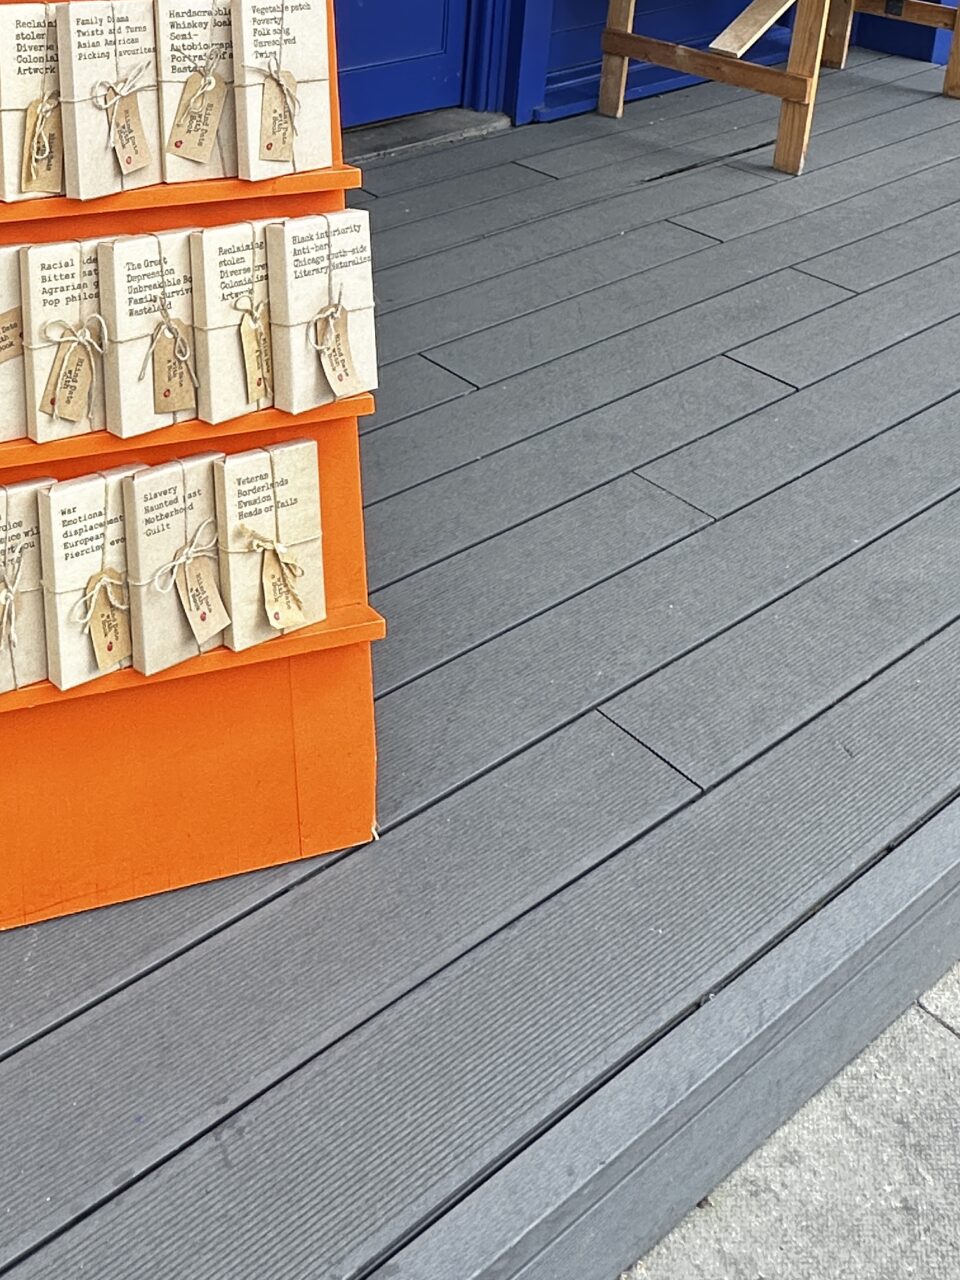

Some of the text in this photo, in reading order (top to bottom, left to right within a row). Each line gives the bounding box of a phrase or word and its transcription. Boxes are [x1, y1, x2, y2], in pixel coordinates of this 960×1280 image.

[290, 2, 311, 13] patch
[76, 17, 103, 26] Family
[169, 21, 208, 30] Whiskey
[252, 16, 283, 25] Poverty
[77, 25, 147, 38] Twists Turns
[169, 33, 199, 41] Semi-
[253, 28, 271, 37] Folk
[77, 40, 100, 49] Asian
[78, 51, 110, 60] Picking
[292, 233, 314, 245] Black
[41, 259, 75, 271] Racial
[126, 261, 142, 271] The
[219, 256, 246, 268] stolen
[293, 255, 324, 267] Chicago
[41, 272, 76, 283] Bitter
[220, 267, 251, 279] Diverse
[294, 266, 329, 279] Literary
[41, 282, 88, 296] Agrarian
[43, 299, 61, 307] Pop
[2, 322, 18, 333] Date
[236, 473, 269, 487] Veteran
[143, 485, 178, 502] Slavery
[144, 497, 179, 514] Haunted
[237, 494, 272, 509] Evasion
[60, 506, 77, 516] War
[62, 507, 107, 527] Emotional
[239, 505, 274, 520] Heads or
[145, 522, 171, 537] Guilt
[63, 531, 105, 550] European
